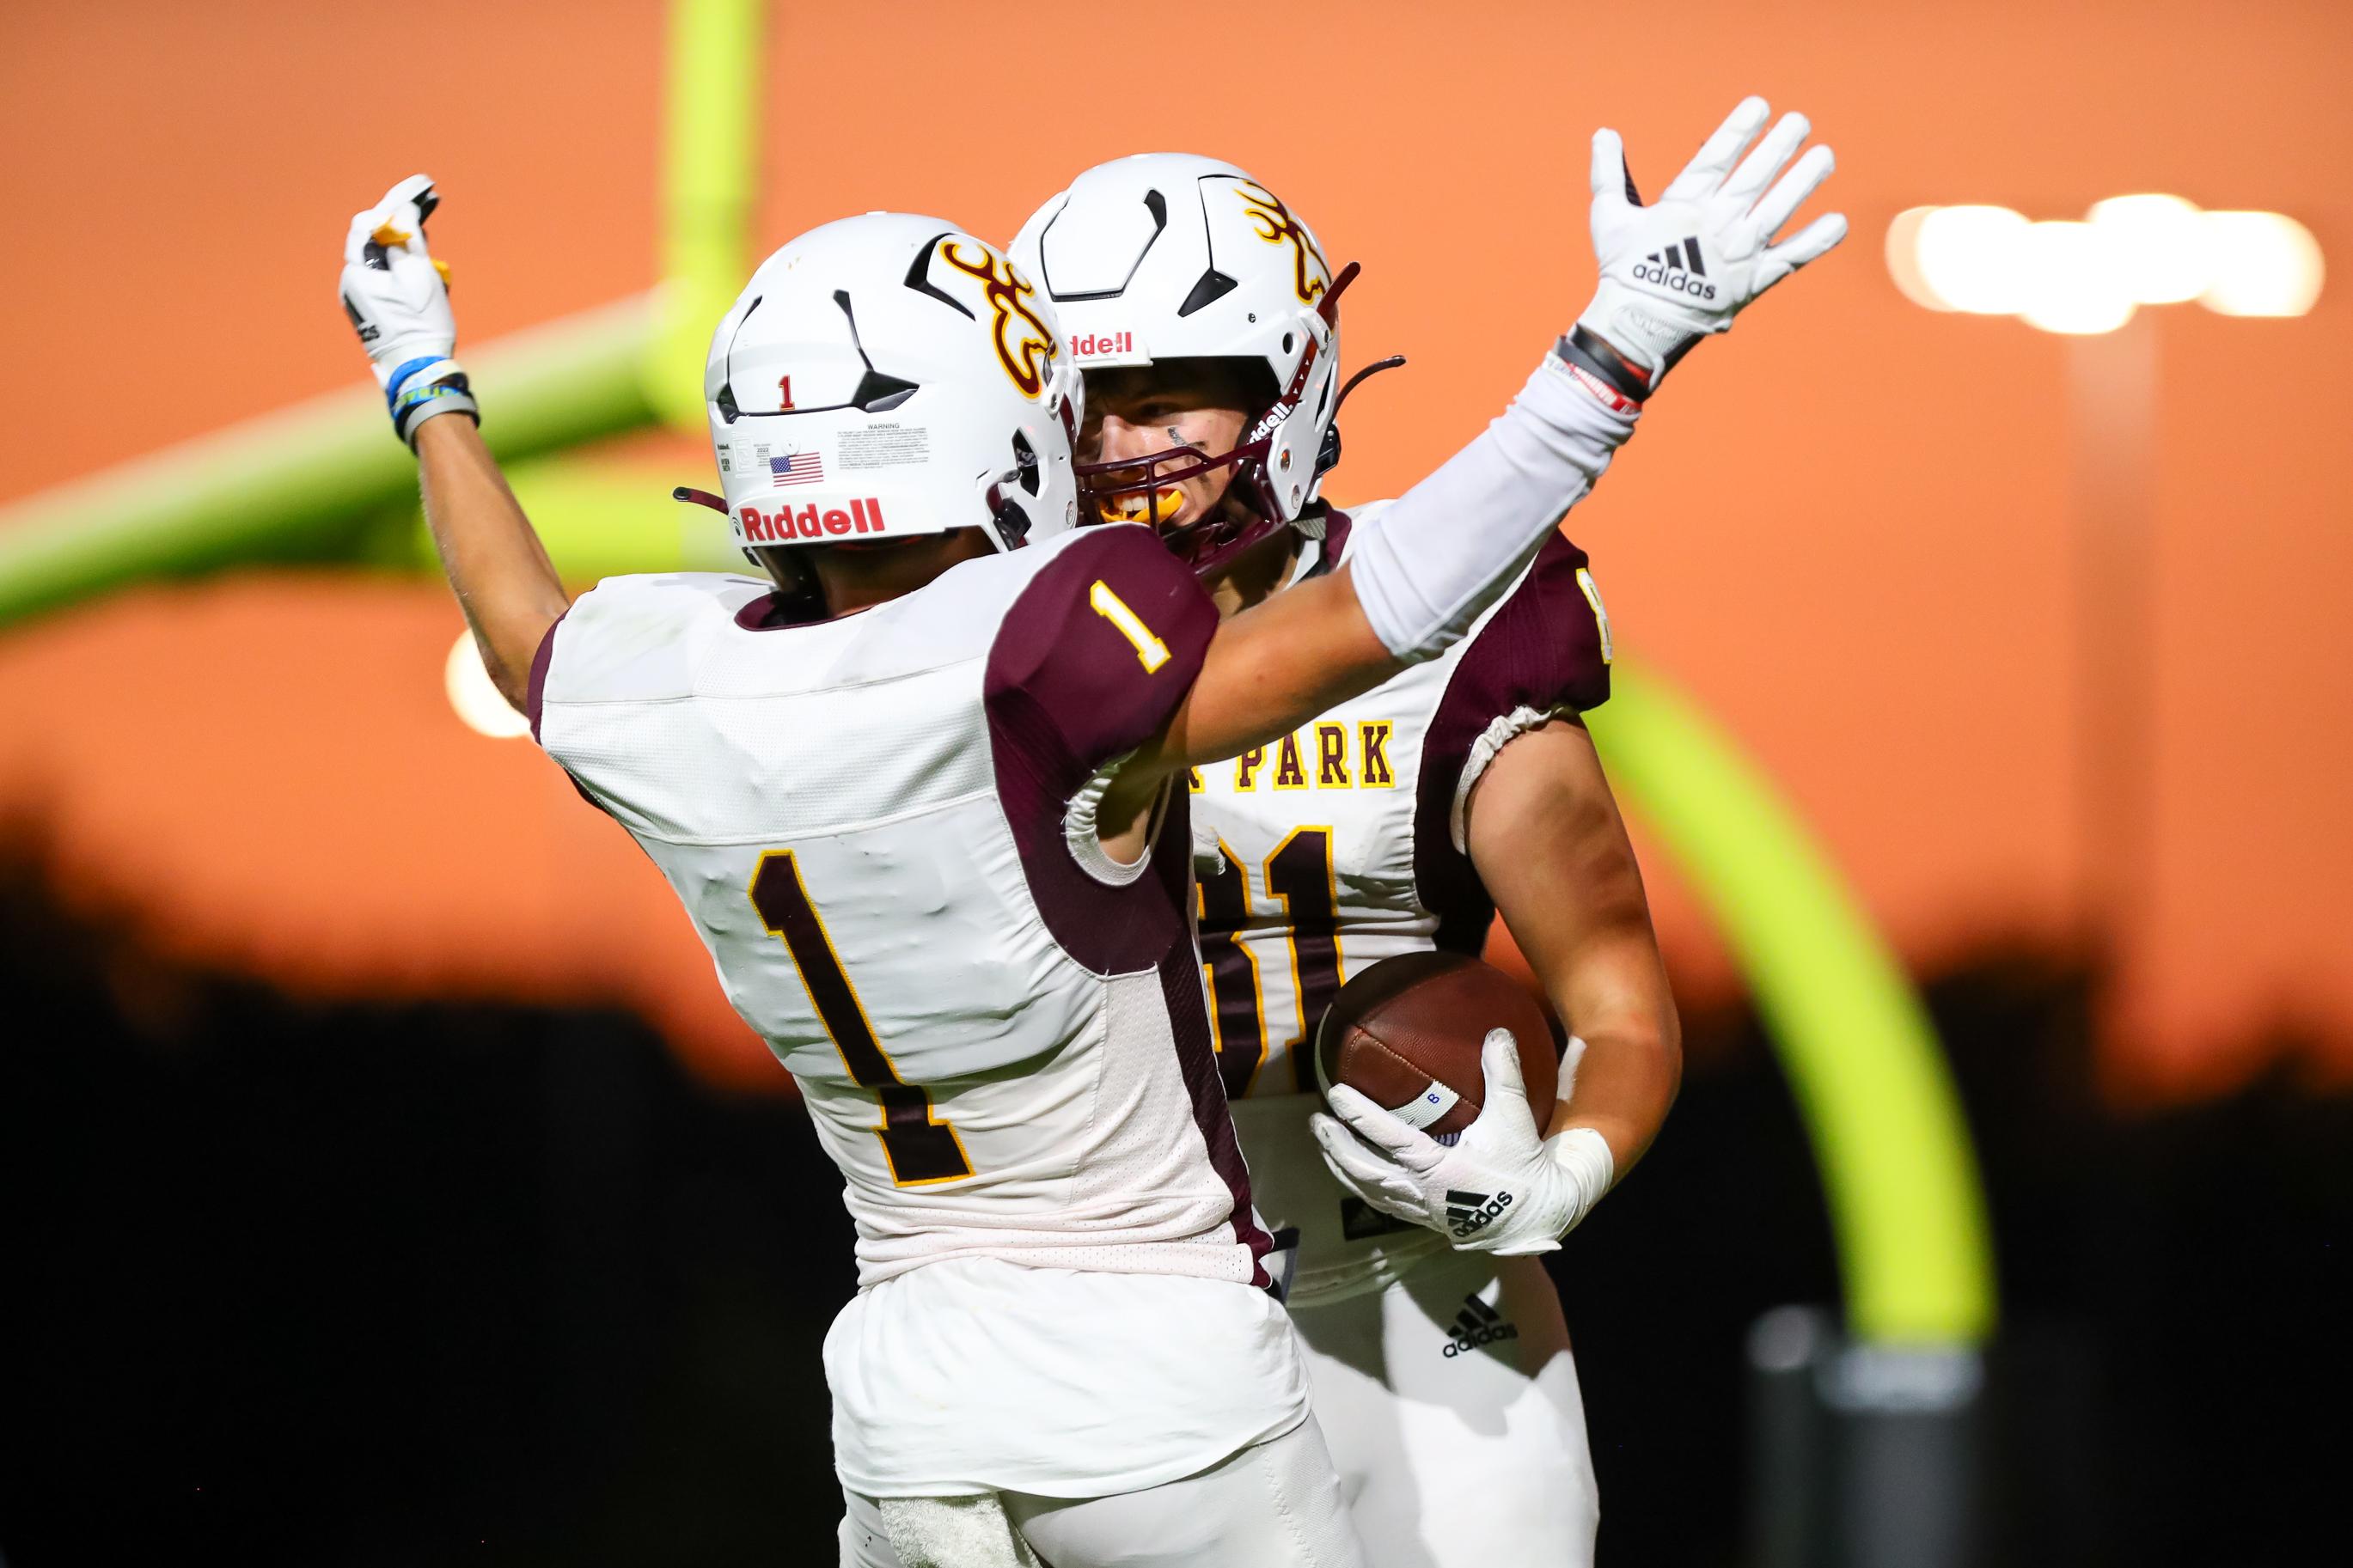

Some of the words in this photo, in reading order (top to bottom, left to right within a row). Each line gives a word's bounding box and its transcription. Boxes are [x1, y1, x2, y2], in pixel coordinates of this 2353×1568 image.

[1631, 263, 1717, 301] adidas
[778, 375, 796, 412] 1
[739, 497, 886, 543] Riddell
[1089, 580, 1173, 675] 1
[1234, 719, 1397, 794] PARK
[746, 848, 977, 1188] 1
[1427, 1093, 1440, 1104] B
[1442, 1322, 1519, 1358] adidas
